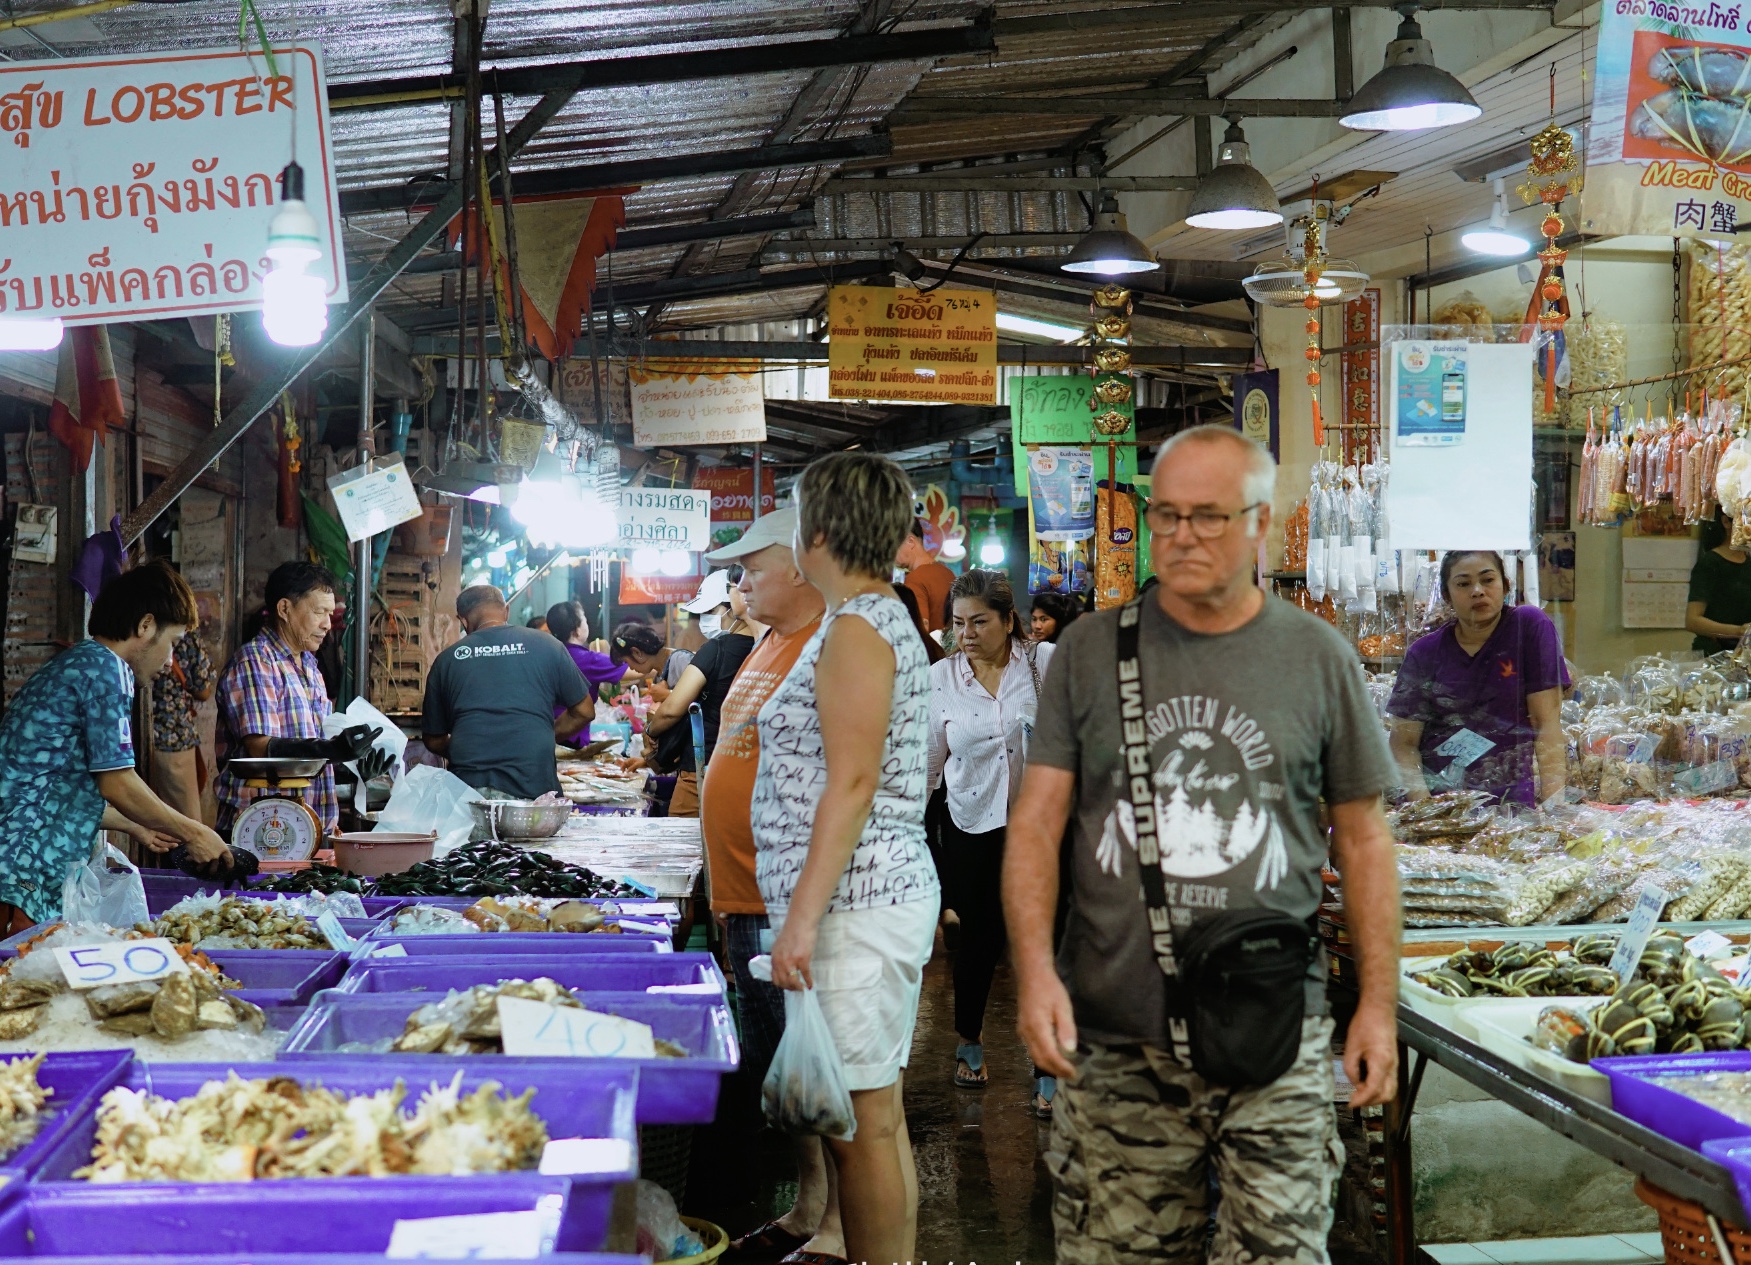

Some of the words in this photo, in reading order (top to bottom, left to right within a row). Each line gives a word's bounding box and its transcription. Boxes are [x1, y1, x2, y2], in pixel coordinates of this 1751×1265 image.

[84, 75, 297, 127] LOBSTER
[1641, 161, 1719, 191] Meat
[1673, 198, 1739, 236] 肉蟹
[474, 643, 524, 655] KOBALT
[1221, 704, 1275, 772] WORLD
[1118, 656, 1161, 867] SUPREME
[1180, 883, 1229, 909] RESERVE
[69, 946, 170, 982] 50
[534, 1008, 627, 1056] 40
